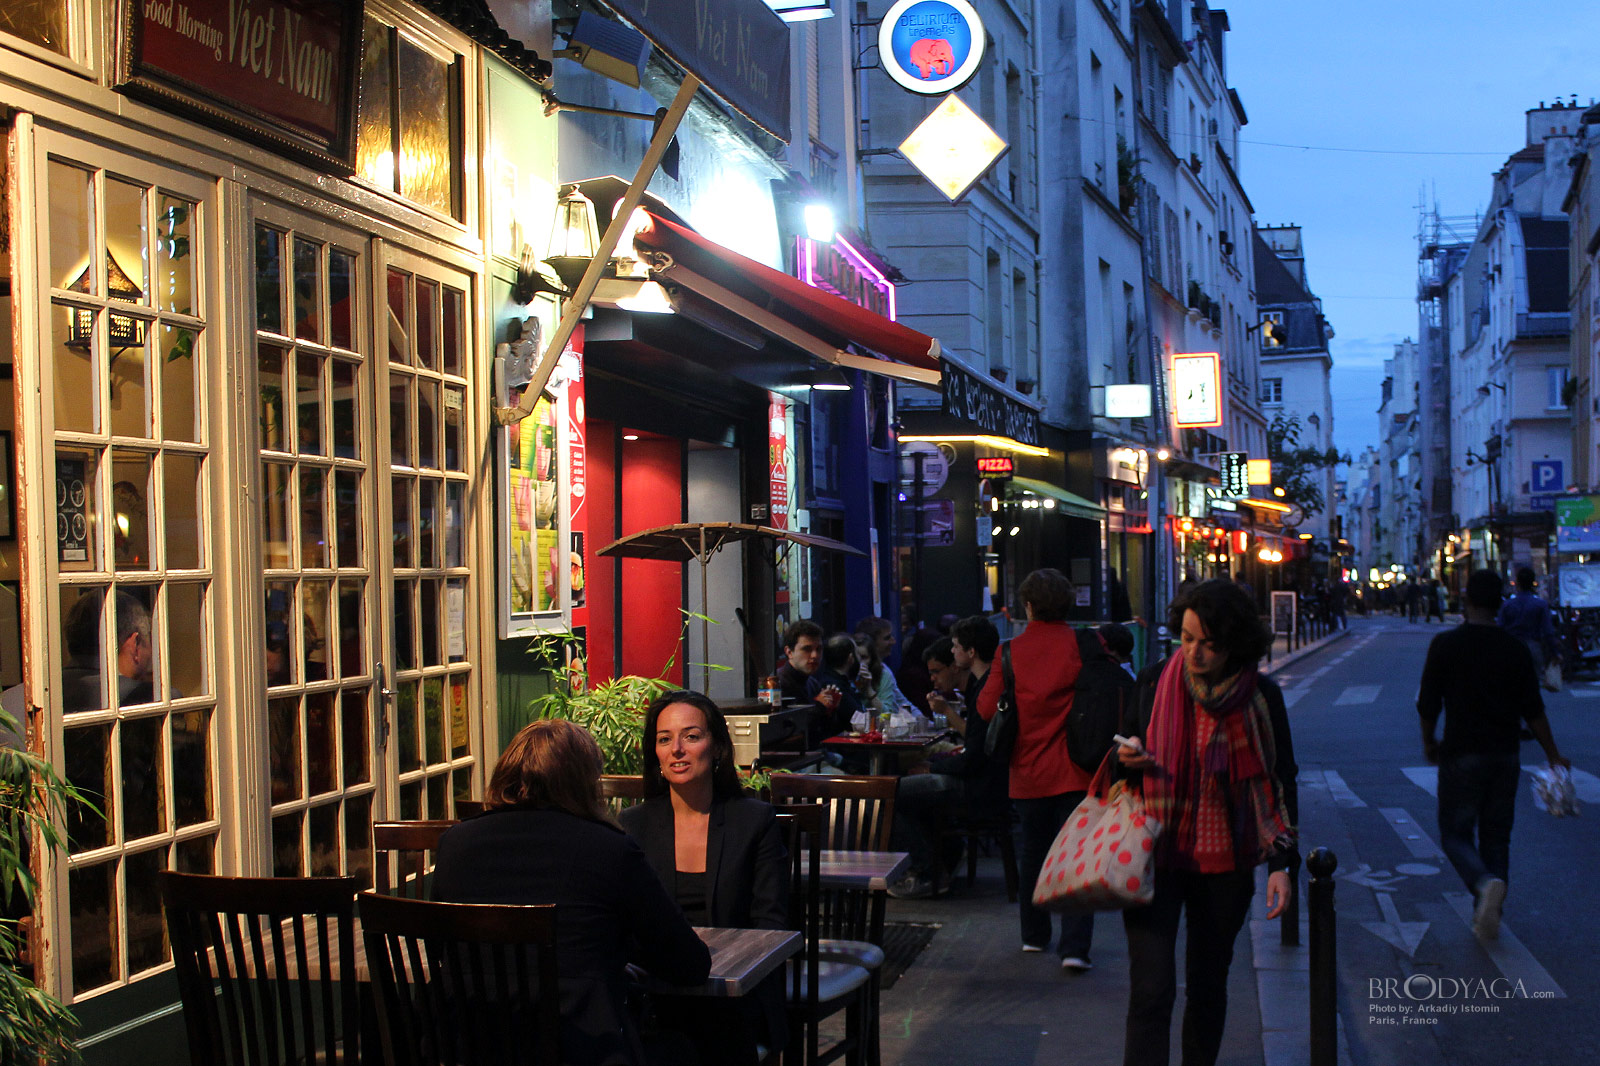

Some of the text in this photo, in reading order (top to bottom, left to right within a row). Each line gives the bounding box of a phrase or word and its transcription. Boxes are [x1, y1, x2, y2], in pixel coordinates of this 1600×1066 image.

[900, 12, 961, 27] DELIRIUM
[176, 4, 224, 62] Morning
[229, 0, 275, 79] Viet
[278, 7, 332, 105] Nam
[696, 0, 768, 98] Viet Nam
[978, 458, 1013, 472] PIZZA
[1539, 465, 1556, 488] P
